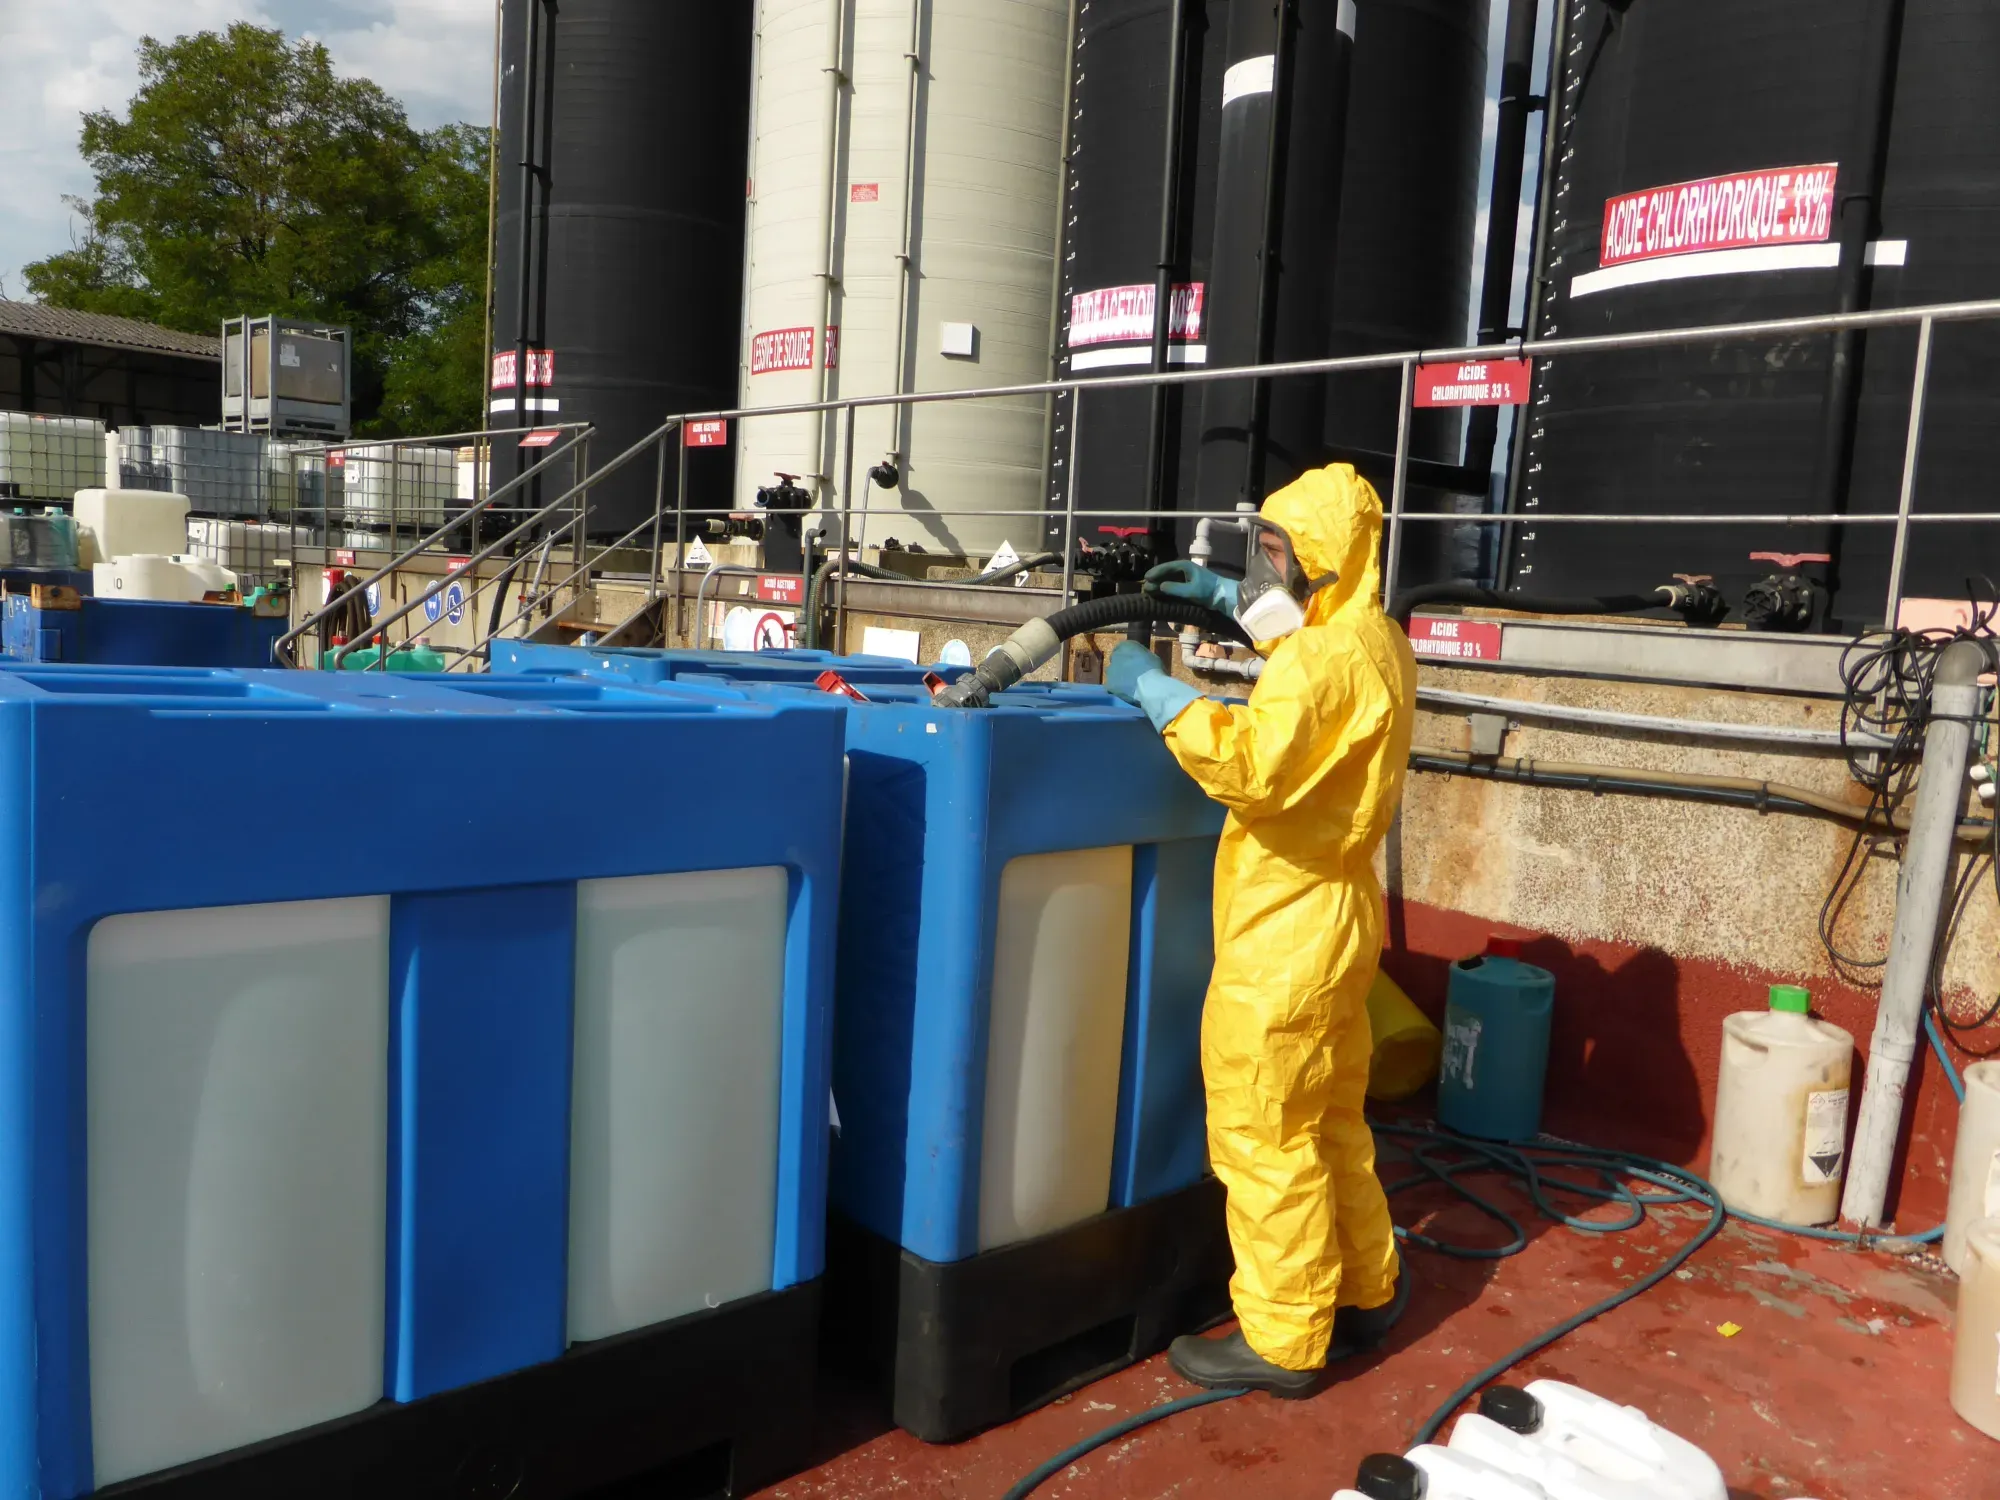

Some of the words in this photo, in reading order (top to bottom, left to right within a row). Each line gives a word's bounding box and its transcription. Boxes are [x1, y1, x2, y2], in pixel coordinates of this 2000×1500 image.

[1605, 196, 1646, 259] ACIDE
[1646, 174, 1790, 252] CHLORHYDRIQUE
[1789, 170, 1829, 237] 33%
[1102, 288, 1154, 338] ACETIQU
[773, 333, 784, 368] DE
[784, 330, 811, 368] SOUDE
[1457, 365, 1487, 380] ACIDE
[1432, 384, 1489, 401] CHLORHYDRIQUE
[1491, 383, 1501, 398] 33
[1504, 383, 1510, 398] %
[1430, 621, 1458, 637] ACIDE
[1409, 639, 1460, 657] HLORHYDRIQUE
[1463, 642, 1473, 657] 33
[1475, 642, 1481, 658] %
